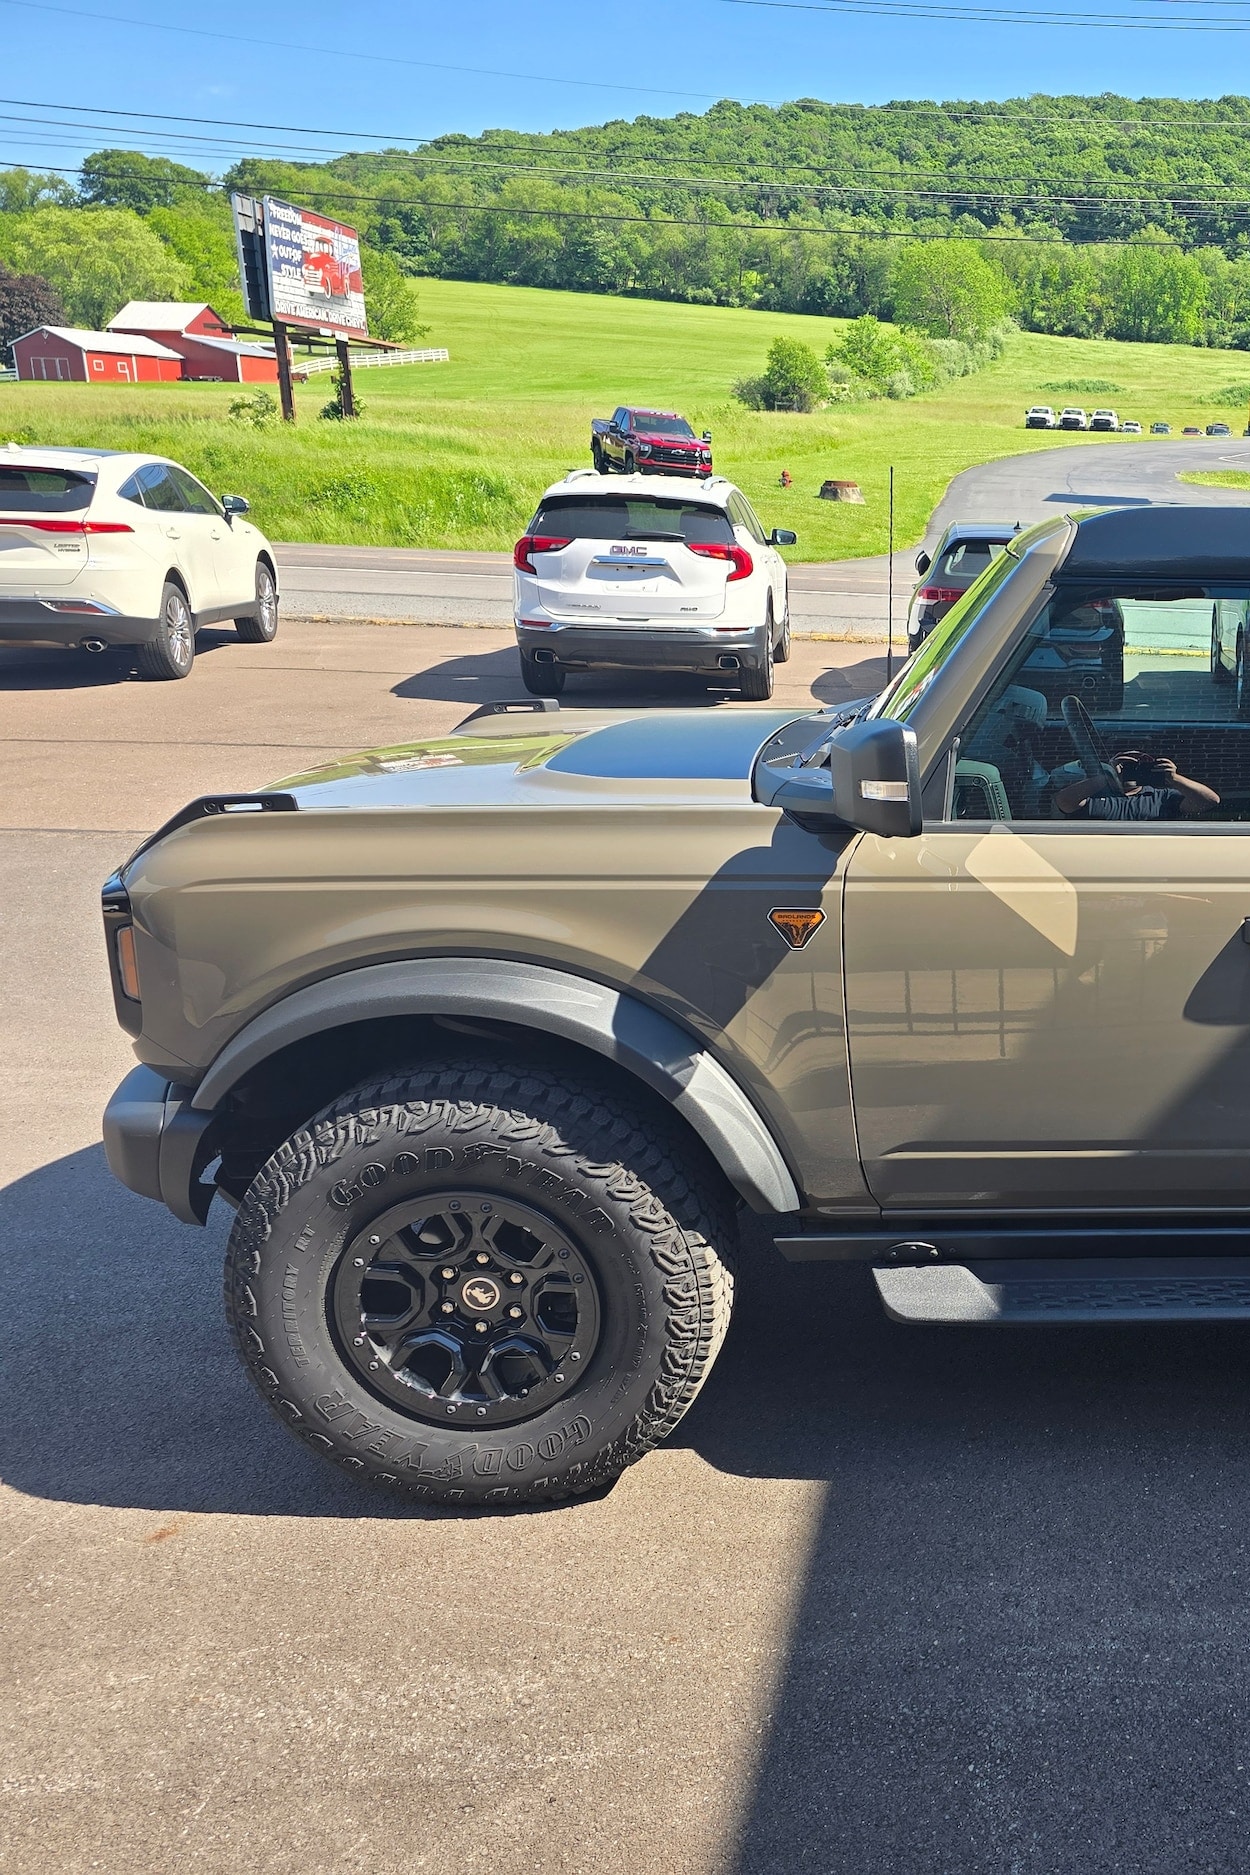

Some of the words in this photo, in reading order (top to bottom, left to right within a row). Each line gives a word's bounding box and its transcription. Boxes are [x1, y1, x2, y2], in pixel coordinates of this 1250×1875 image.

[272, 205, 303, 227] FREEDOM
[269, 223, 291, 242] NEVER
[291, 230, 309, 246] GOES
[278, 244, 293, 259] OUT
[292, 248, 303, 263] OF
[280, 263, 302, 280] STYLE
[275, 300, 297, 316] DRIVE
[328, 311, 347, 327] DRIVE
[610, 545, 647, 556] GMC
[294, 1223, 316, 1252] RT
[282, 1262, 311, 1369] TERRITORY
